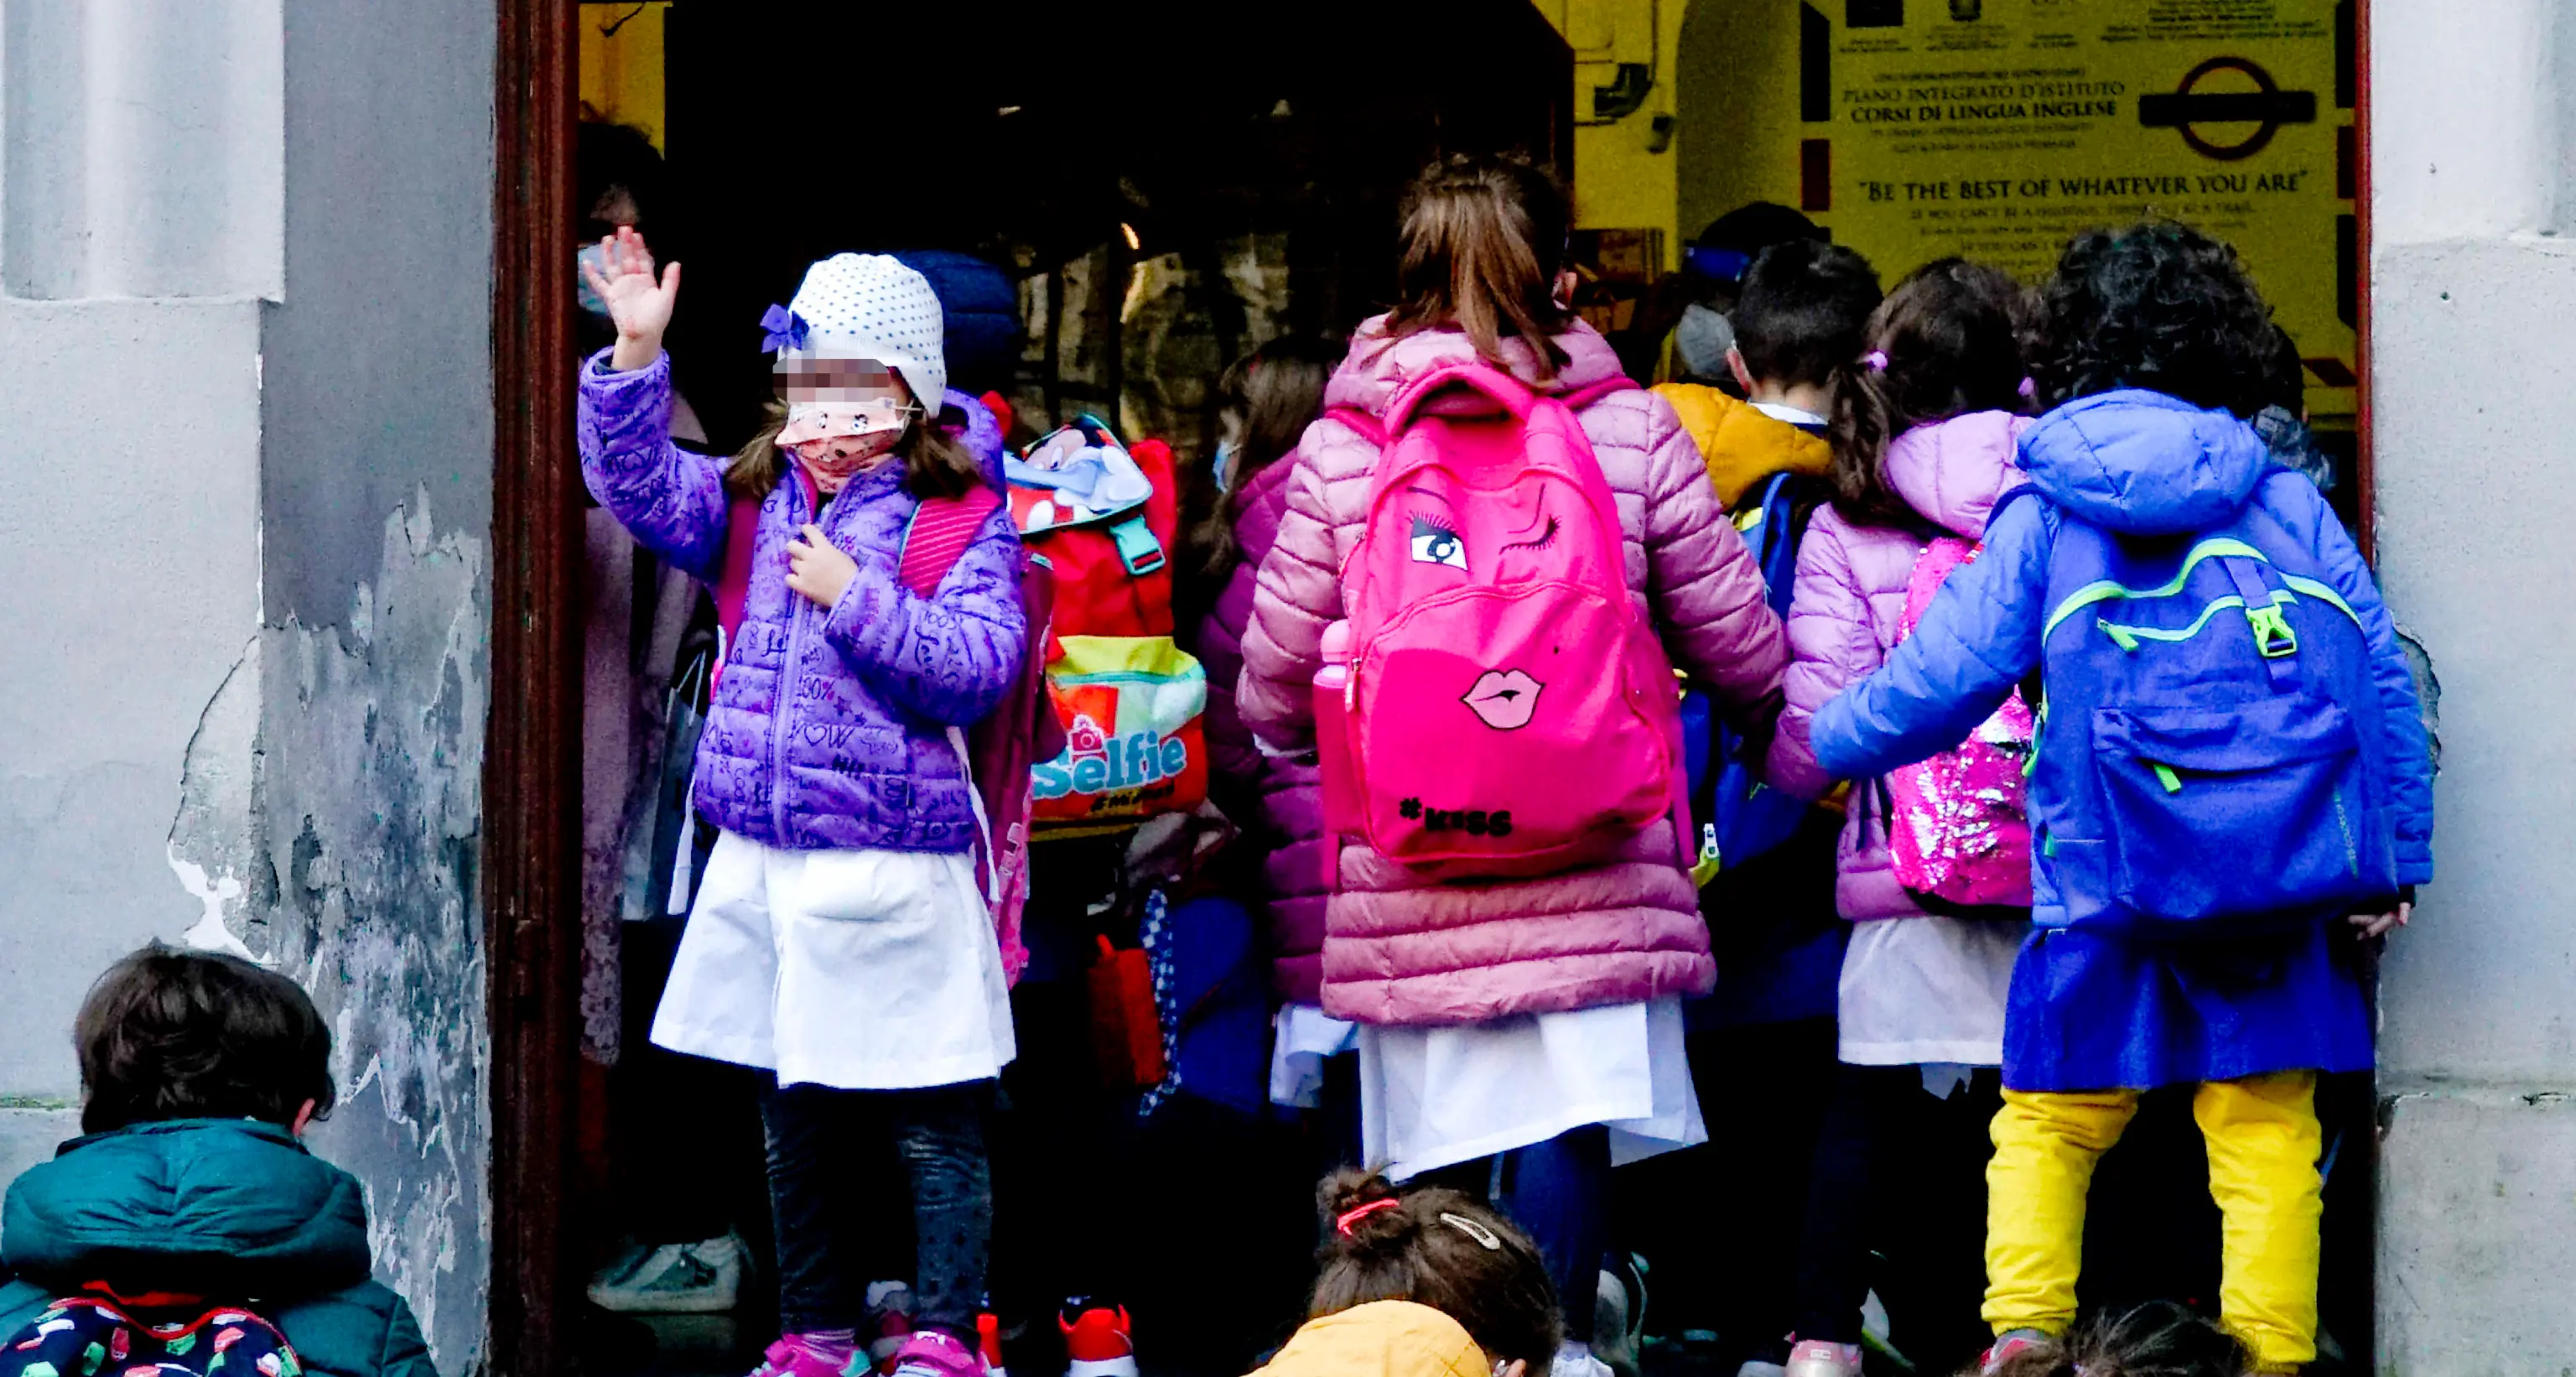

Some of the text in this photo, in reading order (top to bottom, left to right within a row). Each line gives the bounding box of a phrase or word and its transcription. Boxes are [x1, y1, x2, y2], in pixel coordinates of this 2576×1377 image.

[1841, 89, 1902, 103] PIANO
[1908, 85, 2014, 101] INTEGRATO
[1851, 100, 2117, 123] CORSI DI LINGUA INGLESE
[1903, 180, 1950, 201] THE
[1960, 179, 2012, 200] BEST
[2019, 177, 2051, 198] OF
[2060, 175, 2190, 197] WHATEVER
[2196, 174, 2248, 195] YOU
[1031, 730, 1187, 800] Selfie
